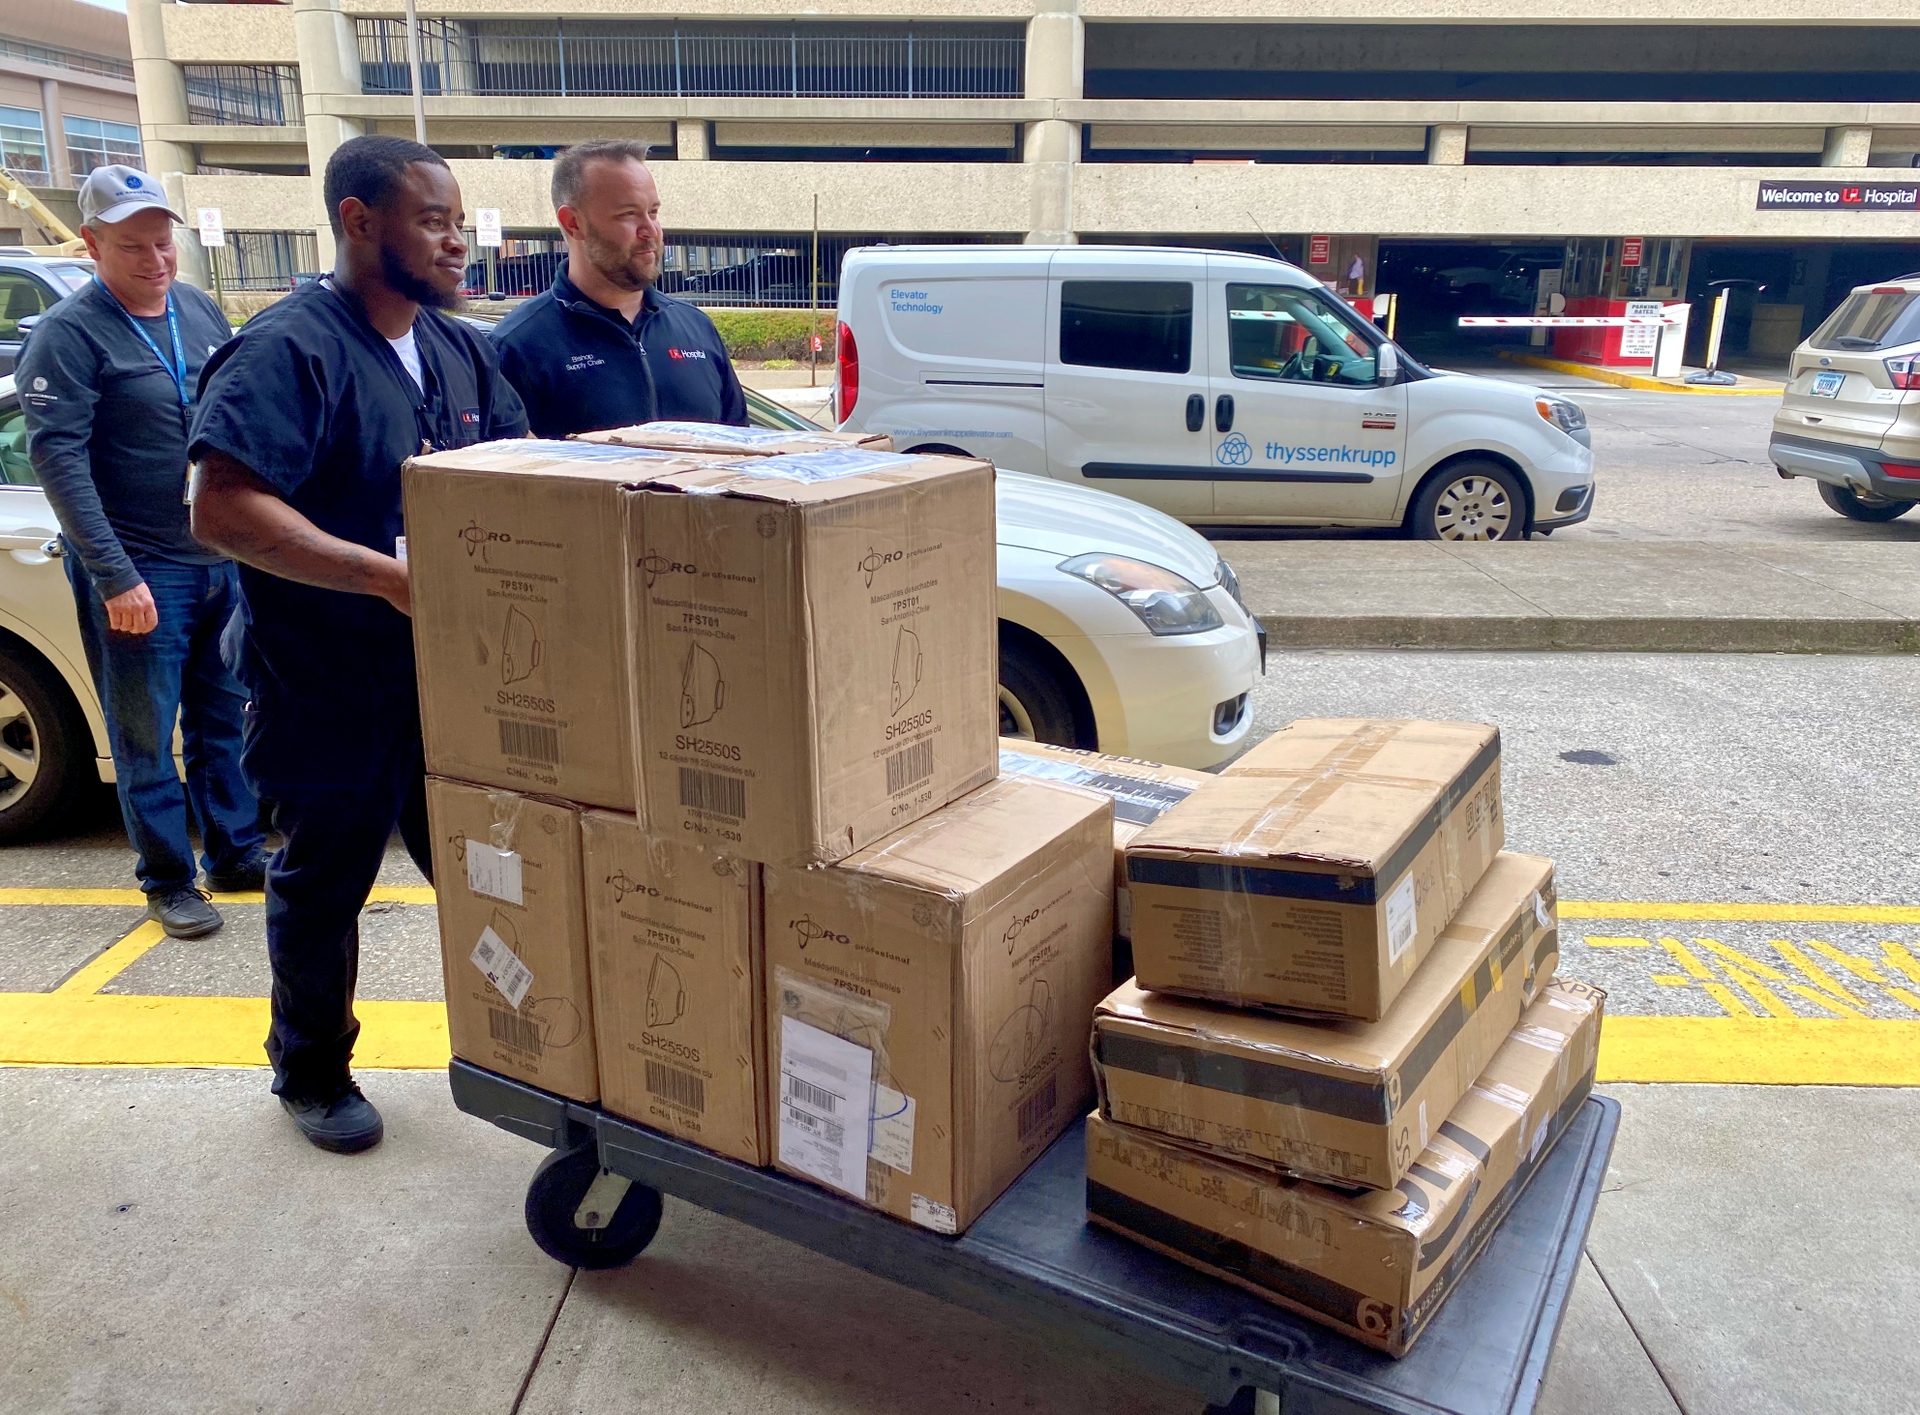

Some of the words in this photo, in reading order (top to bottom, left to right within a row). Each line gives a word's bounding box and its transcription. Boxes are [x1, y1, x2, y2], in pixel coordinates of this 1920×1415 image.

[1762, 188, 1823, 203] Welcome
[1825, 190, 1839, 203] to
[1865, 188, 1917, 206] Hospital
[891, 289, 928, 300] Elevator
[891, 302, 943, 315] Technology
[571, 354, 594, 362] Bishop
[681, 349, 706, 360] Hospital
[566, 361, 587, 371] Supply
[587, 358, 605, 367] Chain
[1266, 442, 1396, 468] thyssenkrupp
[893, 596, 919, 611] 7PST01
[682, 613, 719, 627] 7PST01
[881, 616, 892, 626] San
[497, 690, 556, 713] SH2550S
[885, 709, 932, 740] SH2550S
[675, 734, 741, 761] SH2550S
[873, 748, 880, 758] 12
[895, 741, 902, 750] de
[659, 751, 668, 760] 12
[891, 803, 911, 816] C/No.
[914, 790, 932, 805] 1-530
[716, 828, 742, 842] 1-530
[833, 978, 871, 997] 7PST01
[641, 1031, 700, 1062] SH2550S
